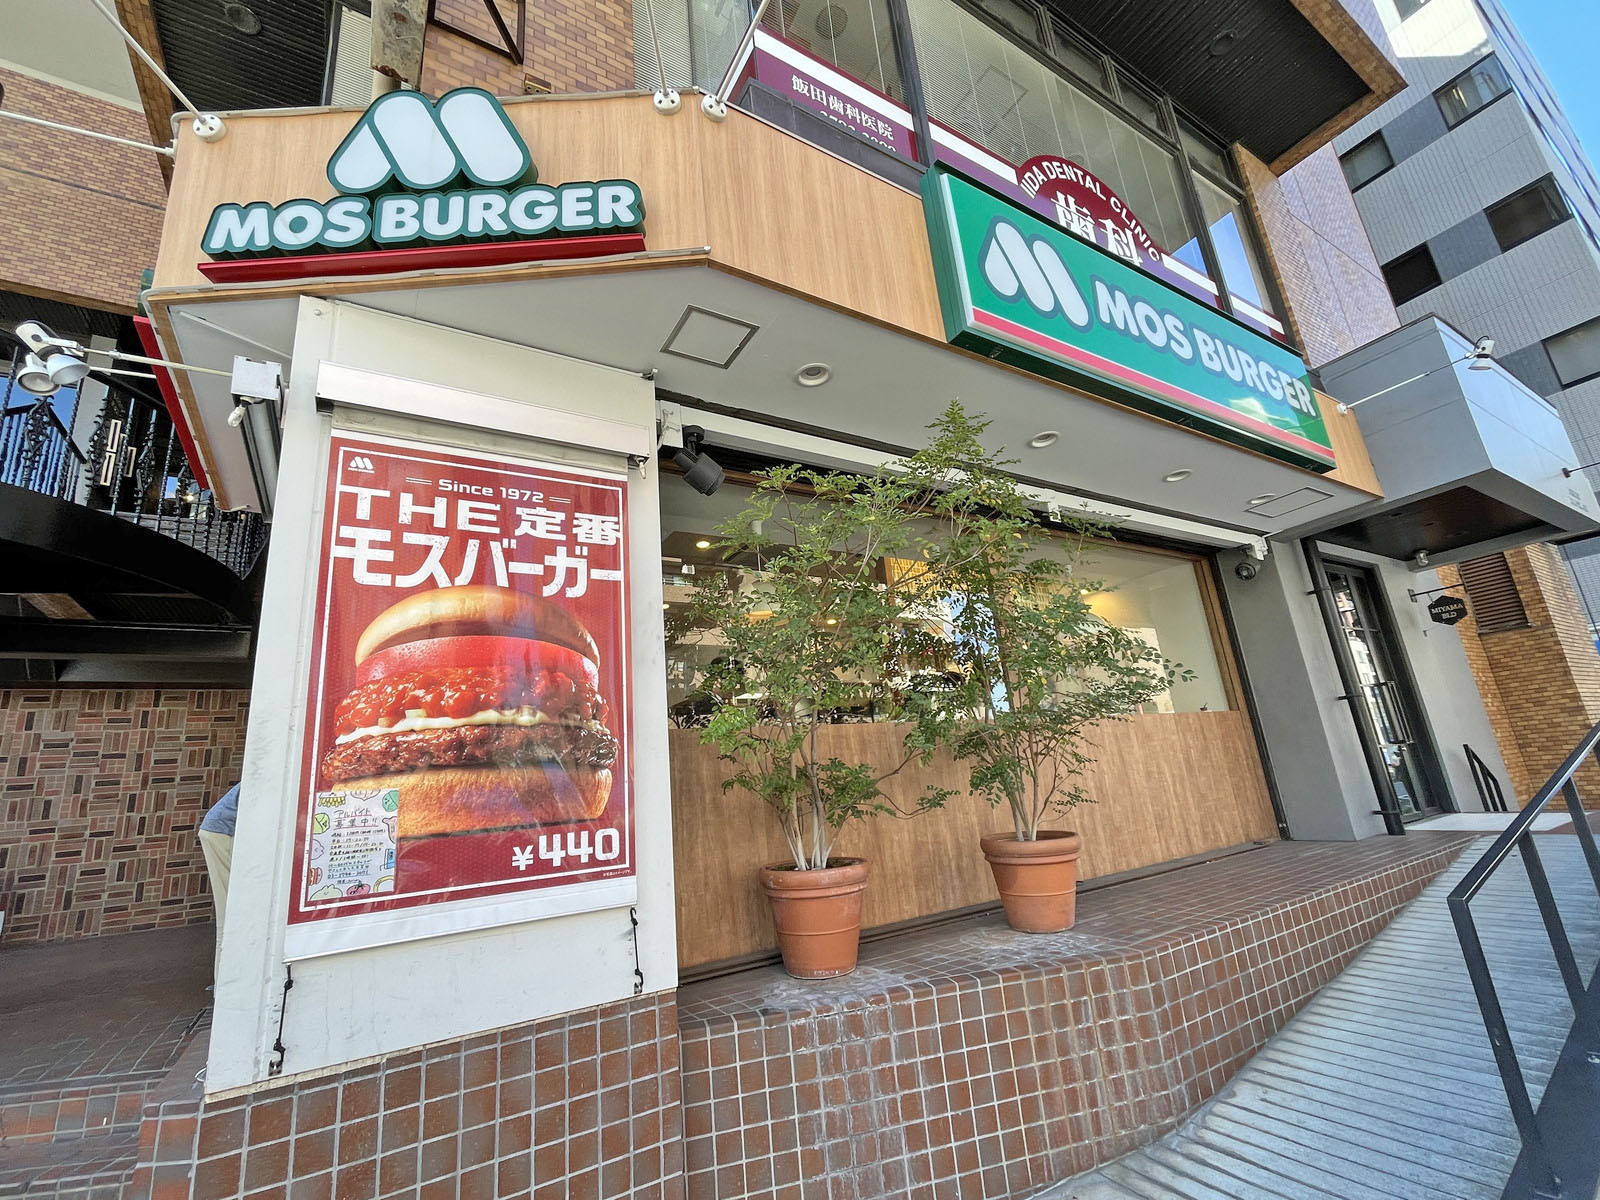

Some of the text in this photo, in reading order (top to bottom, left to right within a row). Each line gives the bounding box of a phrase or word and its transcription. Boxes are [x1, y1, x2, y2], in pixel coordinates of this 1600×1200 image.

[792, 75, 894, 140] 飯田歯科医院
[209, 185, 642, 249] MOS BURGER
[1042, 161, 1106, 201] DENTAL
[1110, 196, 1159, 262] CLINIC
[1095, 280, 1317, 417] MOS BURGER
[338, 484, 621, 546] THE 定番
[438, 479, 544, 503] Since 1972
[333, 525, 624, 598] モスバーガー
[1431, 603, 1464, 614] MIYAMA
[511, 827, 620, 871] ¥440
